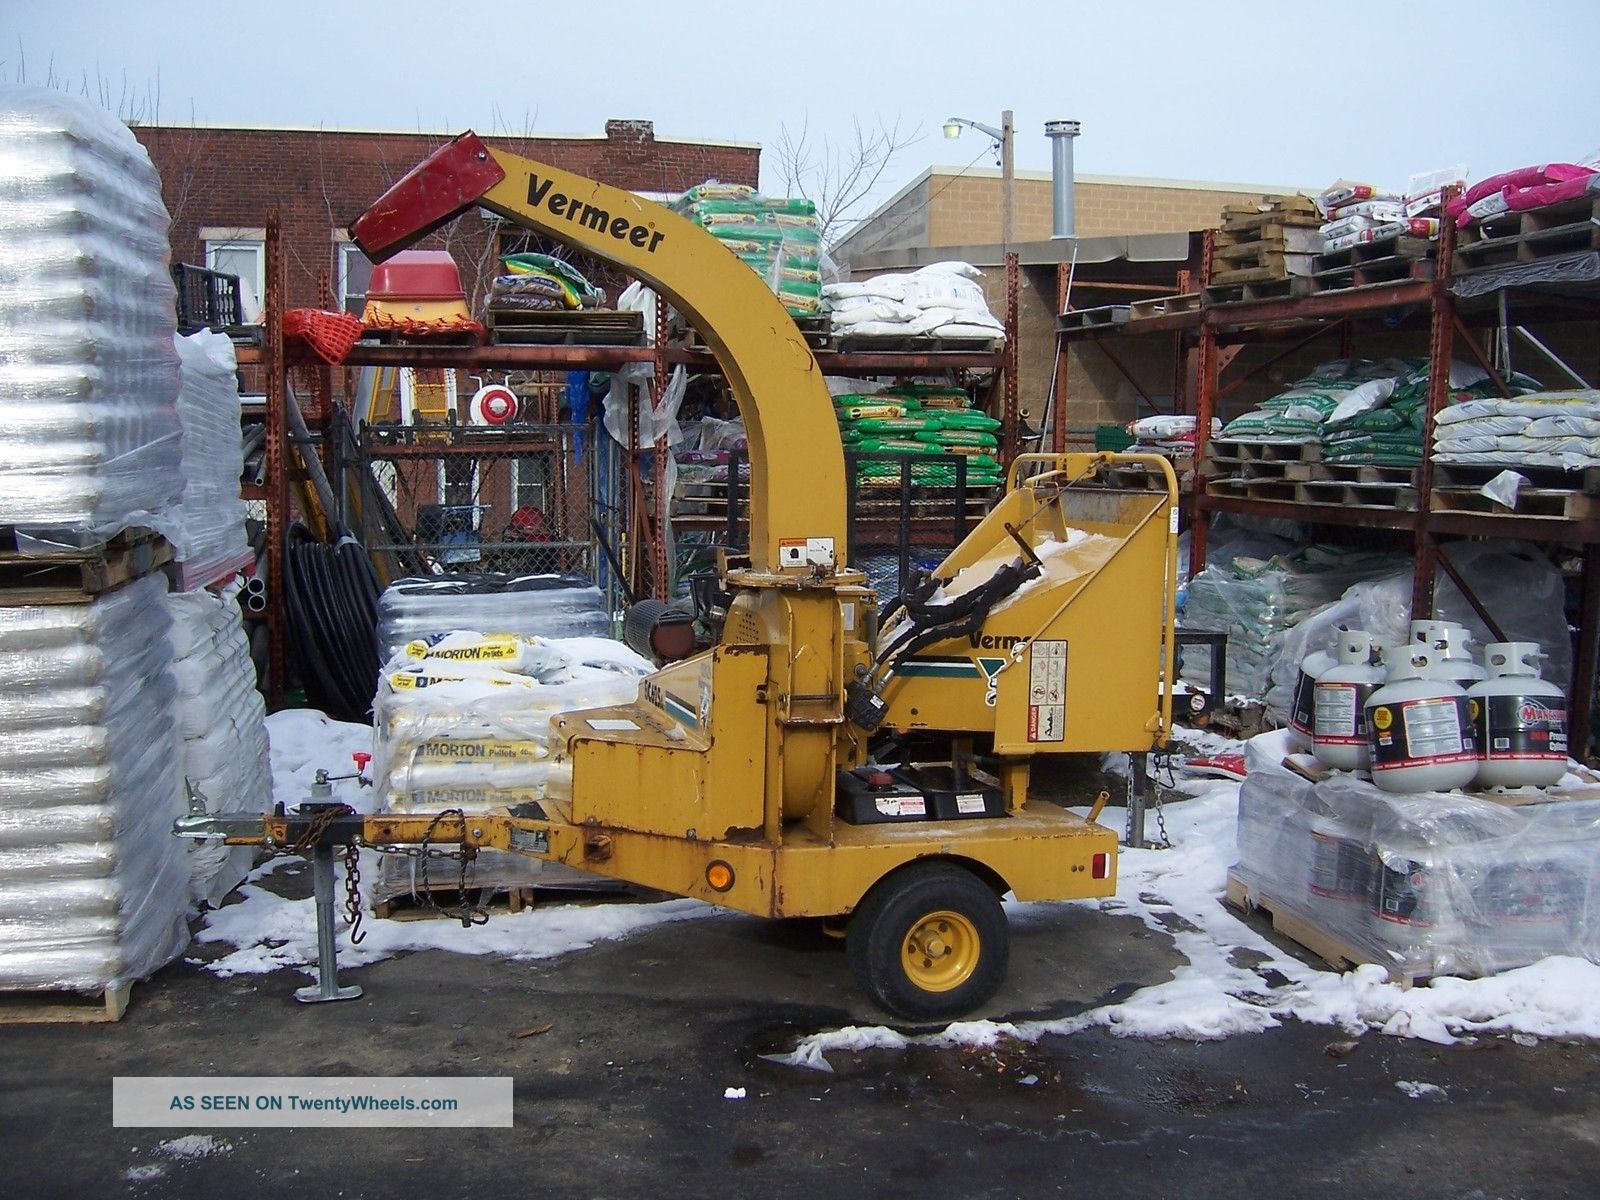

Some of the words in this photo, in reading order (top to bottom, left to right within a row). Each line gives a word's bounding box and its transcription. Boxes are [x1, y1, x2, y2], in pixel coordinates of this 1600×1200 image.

[526, 172, 665, 254] Vermeer
[970, 631, 1032, 649] Verm
[433, 647, 481, 659] MORTON
[426, 743, 485, 757] MORTON
[426, 788, 486, 803] MORTON
